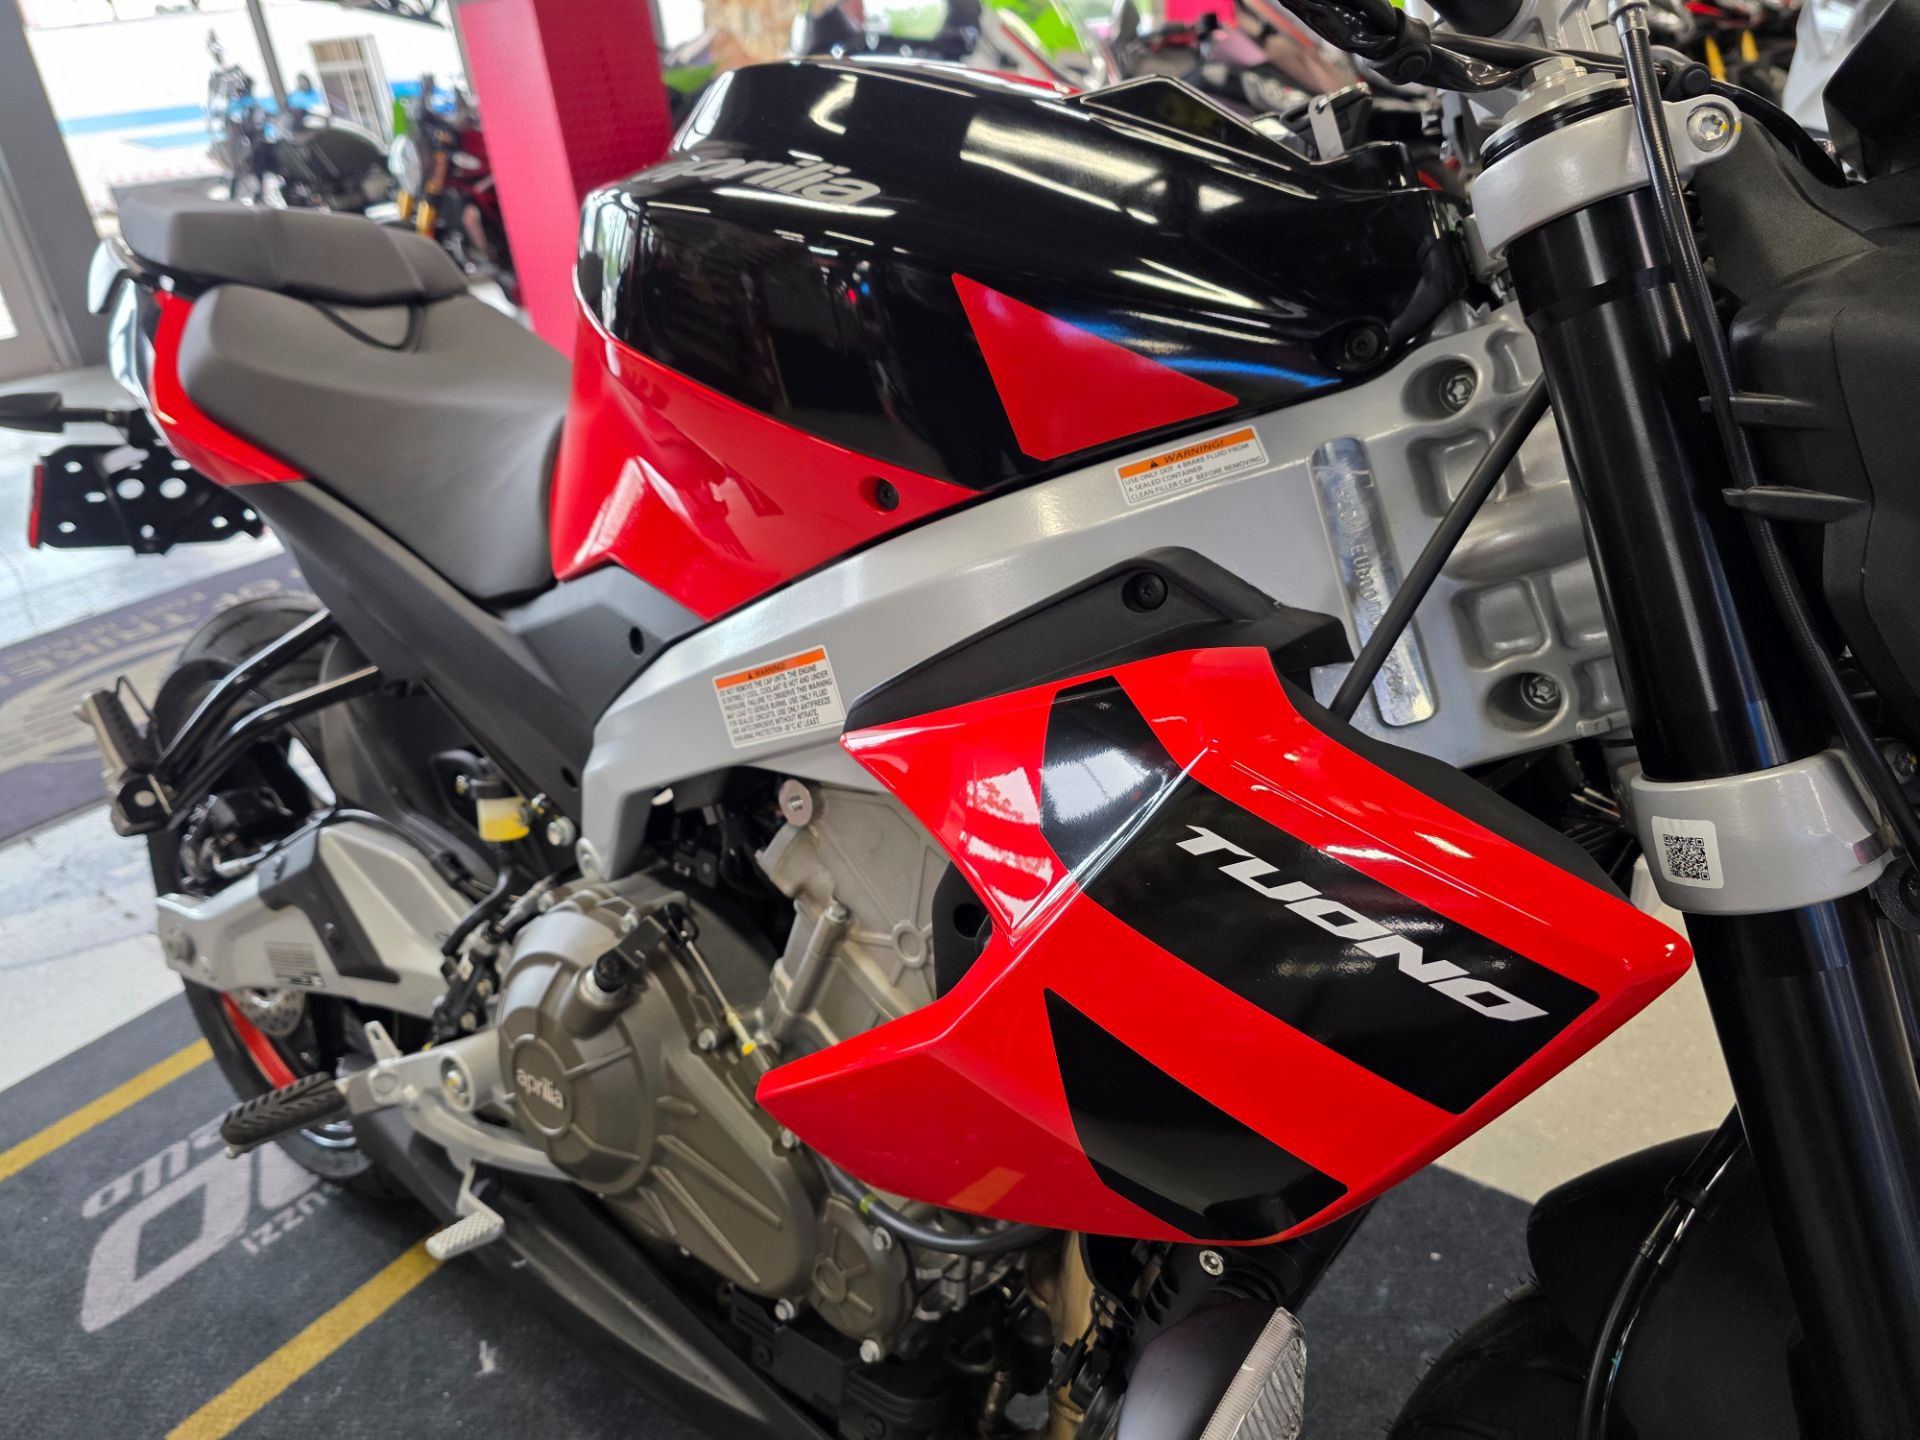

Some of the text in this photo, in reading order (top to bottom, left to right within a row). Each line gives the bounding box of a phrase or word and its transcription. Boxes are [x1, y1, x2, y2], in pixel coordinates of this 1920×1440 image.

[1125, 476, 1138, 485] USE
[1139, 471, 1159, 481] ONLY
[1160, 466, 1174, 475] DOT
[1182, 457, 1205, 468] BRAKE
[1207, 451, 1227, 462] FLUID
[1228, 443, 1249, 454] FROM
[1164, 439, 1224, 464] WARNING!
[1131, 455, 1263, 500] CLEAN FILLER CAP BEFORE REMOVING
[1134, 477, 1161, 491] SEALED
[1162, 466, 1203, 483] CONTAINER
[798, 664, 817, 676] ENGINE
[810, 669, 828, 680] UNDER
[799, 691, 812, 702] ONLY
[813, 688, 828, 699] FLUID
[801, 695, 832, 710] ANTIFREEZE
[1176, 824, 1550, 1021] TUONO
[516, 1068, 564, 1110] aprilia
